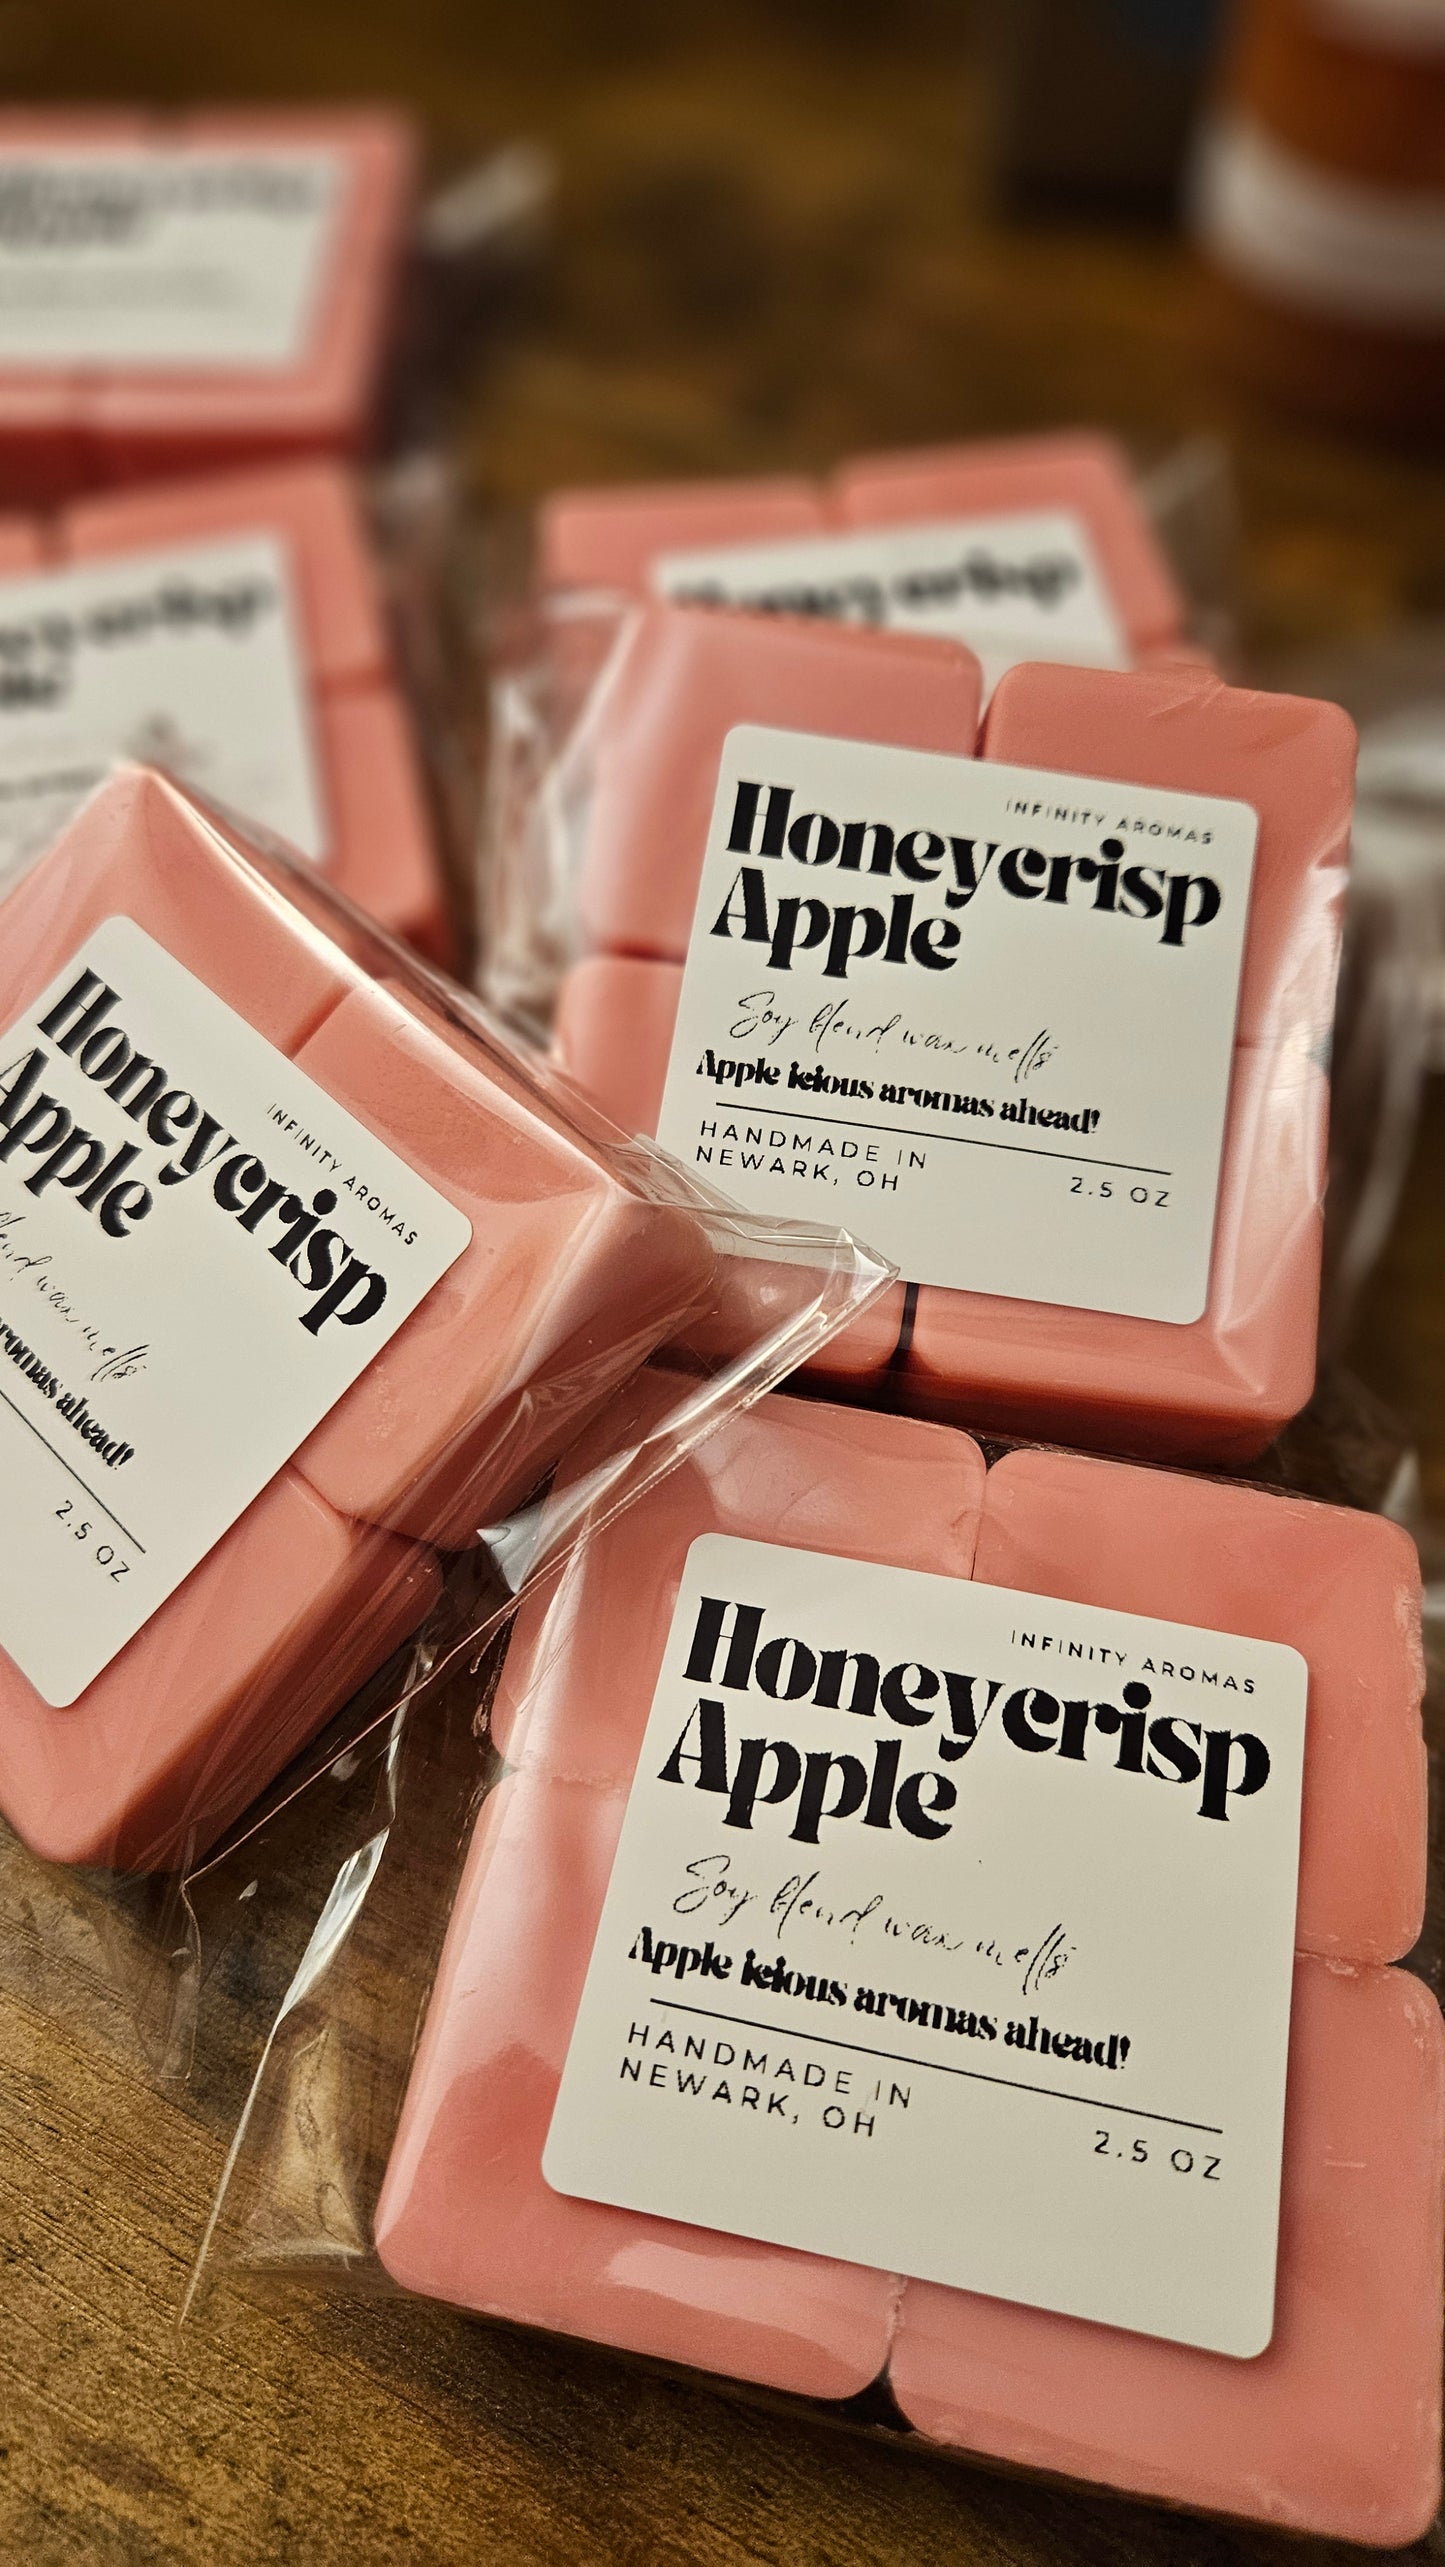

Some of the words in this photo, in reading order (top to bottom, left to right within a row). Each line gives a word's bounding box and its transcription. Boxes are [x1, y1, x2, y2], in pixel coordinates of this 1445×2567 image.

[725, 780, 1222, 947] Honeycrisp
[1006, 798, 1105, 827] INFINITY
[1116, 817, 1214, 845] AROMAS
[709, 866, 961, 978] Apple
[730, 991, 798, 1045] Soy
[810, 999, 902, 1052] blend
[902, 1029, 966, 1054] wax
[980, 1028, 1059, 1084] melts
[696, 1049, 781, 1087] Apple
[787, 1061, 874, 1101] icious
[879, 1083, 994, 1118] aromas
[999, 1097, 1100, 1135] ahead!
[37, 967, 387, 1336] Honeycrisp
[266, 1103, 342, 1173] INFINITY
[343, 1176, 418, 1246] AROMAS
[696, 1145, 839, 1186] NEWARK,
[857, 1170, 899, 1191] OH
[701, 1120, 880, 1163] HANDMADE
[898, 1148, 926, 1169] IN
[1070, 1177, 1113, 1198] 2.5
[1130, 1186, 1171, 1208] OZ
[37, 1274, 79, 1323] wax
[82, 1325, 150, 1382] melts
[0, 1316, 63, 1400] romas
[56, 1387, 135, 1470] ahead!
[54, 1500, 93, 1540] 2.5
[97, 1545, 130, 1582] OZ
[682, 1595, 1271, 1821] Honeycrisp
[1011, 1628, 1128, 1667] INFINITY
[1140, 1657, 1256, 1695] AROMAS
[656, 1697, 957, 1844] Apple
[673, 1854, 757, 1925] Soy
[770, 1871, 885, 1944] blend
[884, 1915, 964, 1952] wax
[975, 1923, 1076, 1996] melts
[627, 1925, 733, 1981] Apple
[740, 1947, 849, 2007] icious
[853, 1985, 998, 2043] aromas
[1003, 2015, 1131, 2071] ahead!
[619, 2057, 800, 2126] NEWARK,
[822, 2105, 876, 2138] OH
[627, 2022, 853, 2096] HANDMADE
[873, 2079, 912, 2110] IN
[1092, 2130, 1149, 2164] 2.5
[1170, 2147, 1222, 2182] OZ
